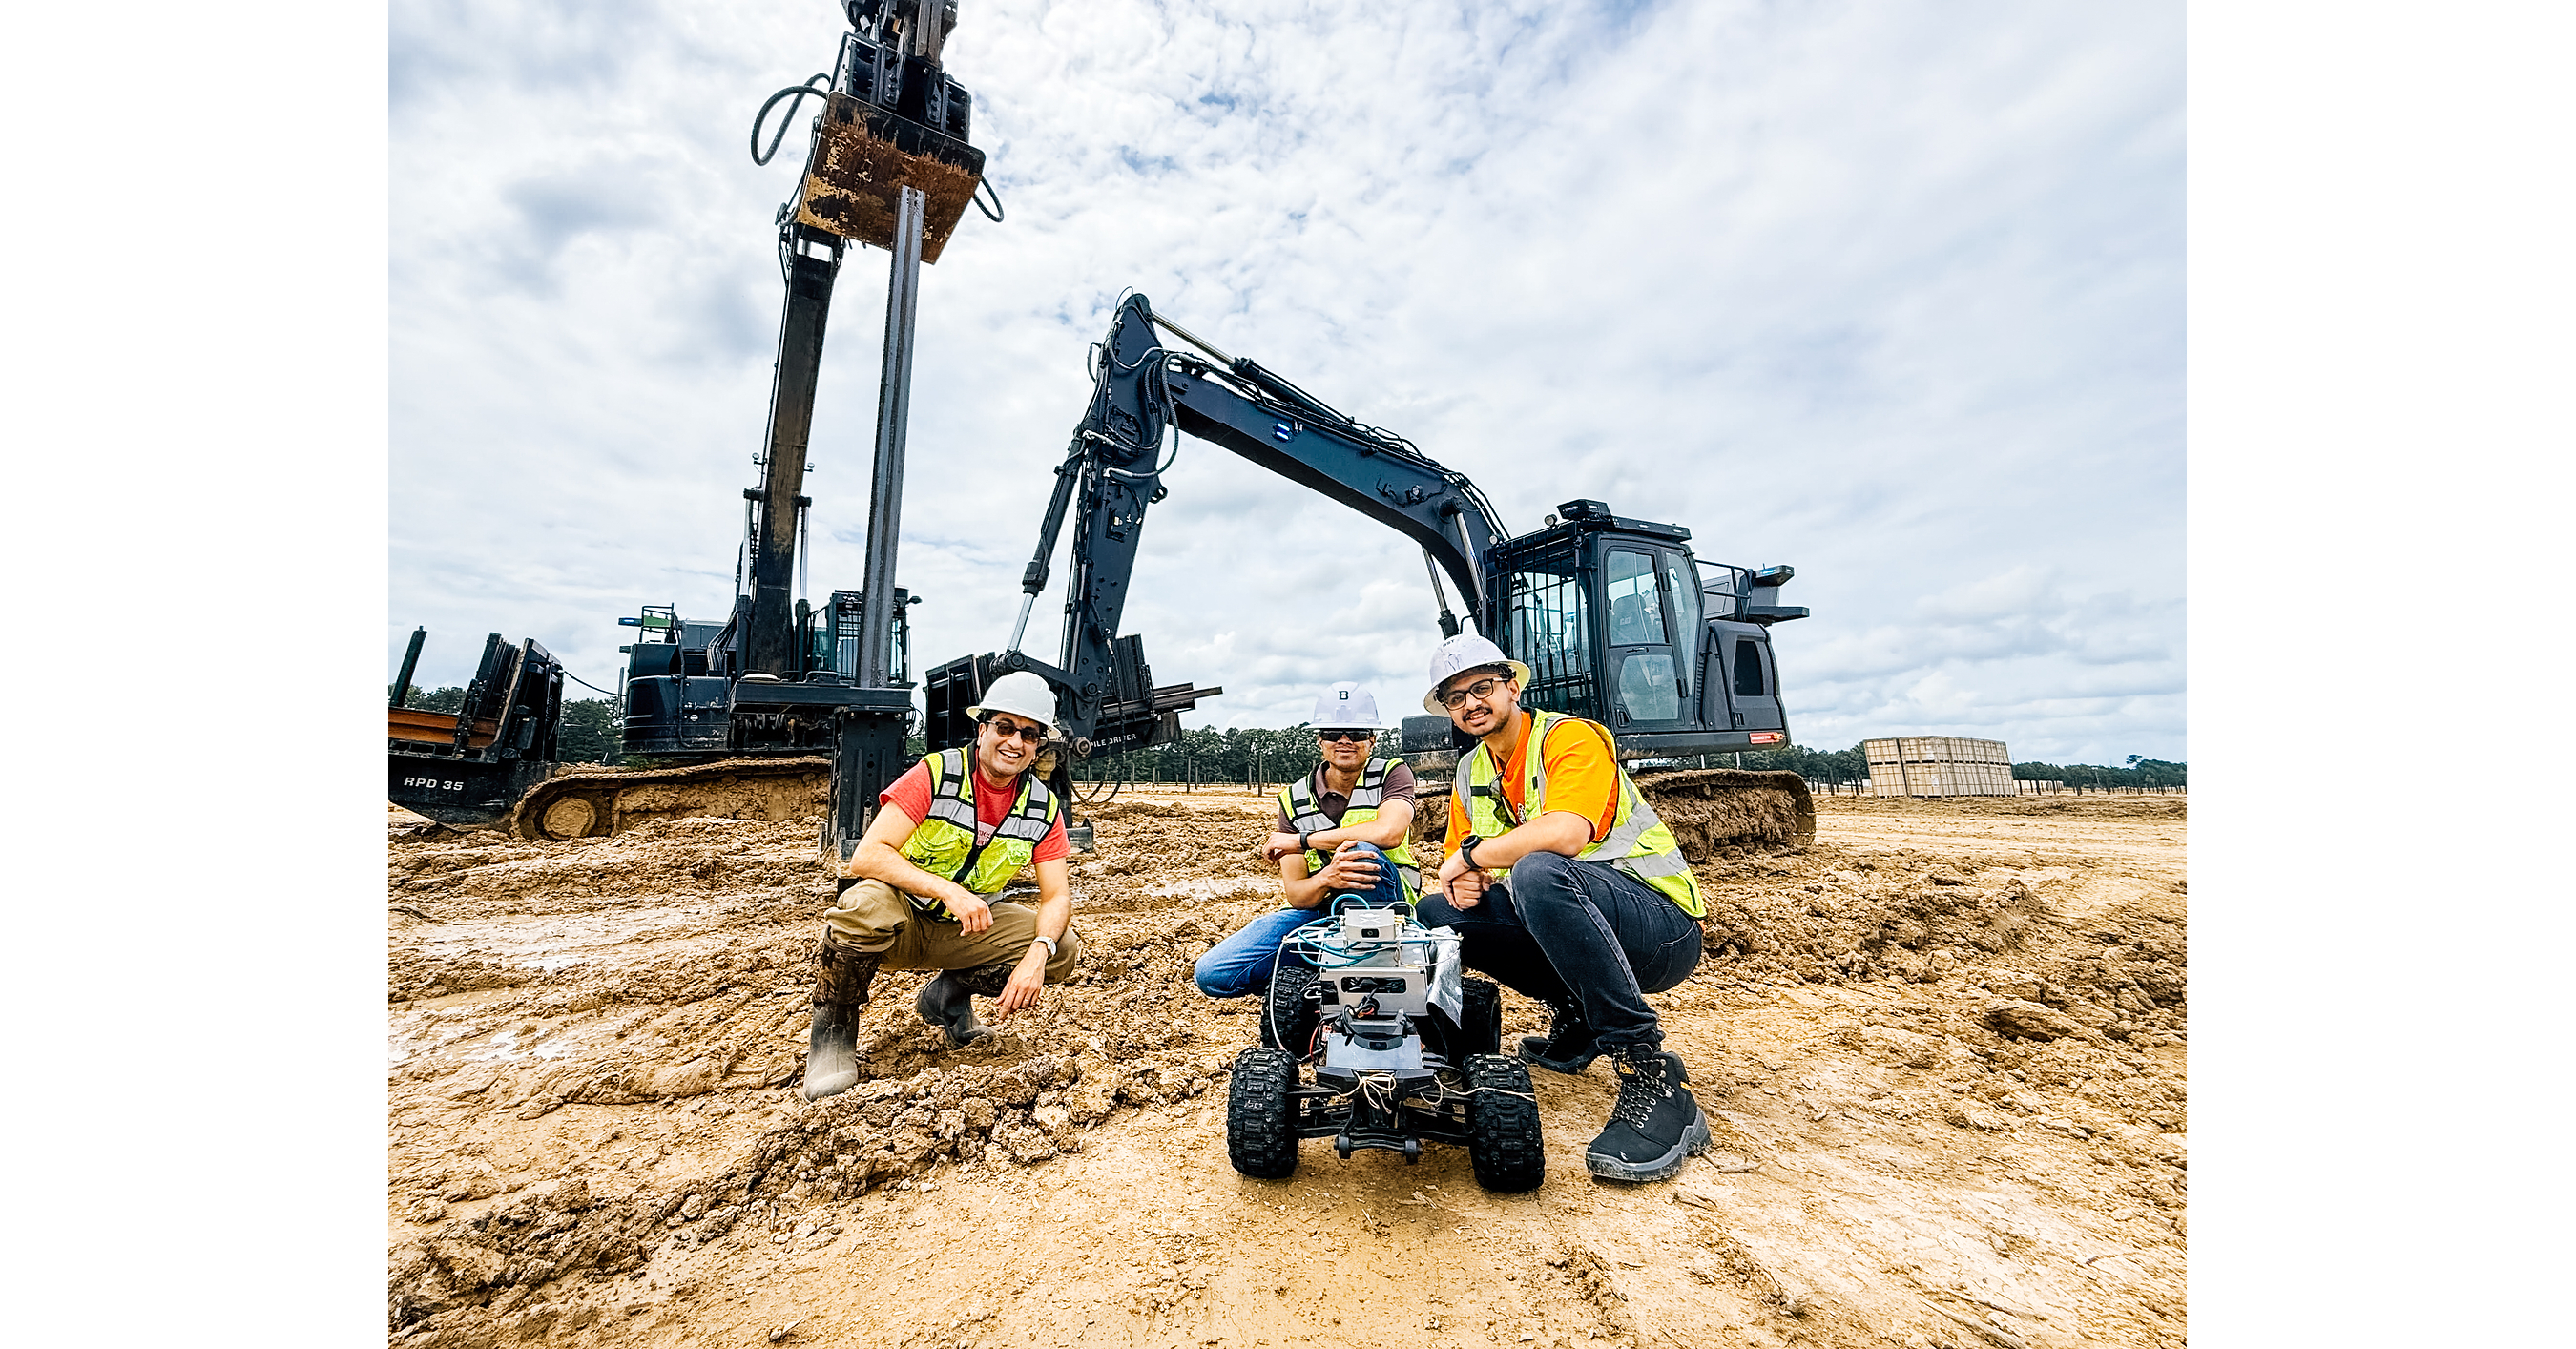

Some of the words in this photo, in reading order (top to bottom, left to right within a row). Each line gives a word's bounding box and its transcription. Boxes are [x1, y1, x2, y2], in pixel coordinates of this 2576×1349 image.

[1339, 690, 1349, 700] B
[404, 777, 438, 788] RPD
[442, 780, 465, 791] 35
